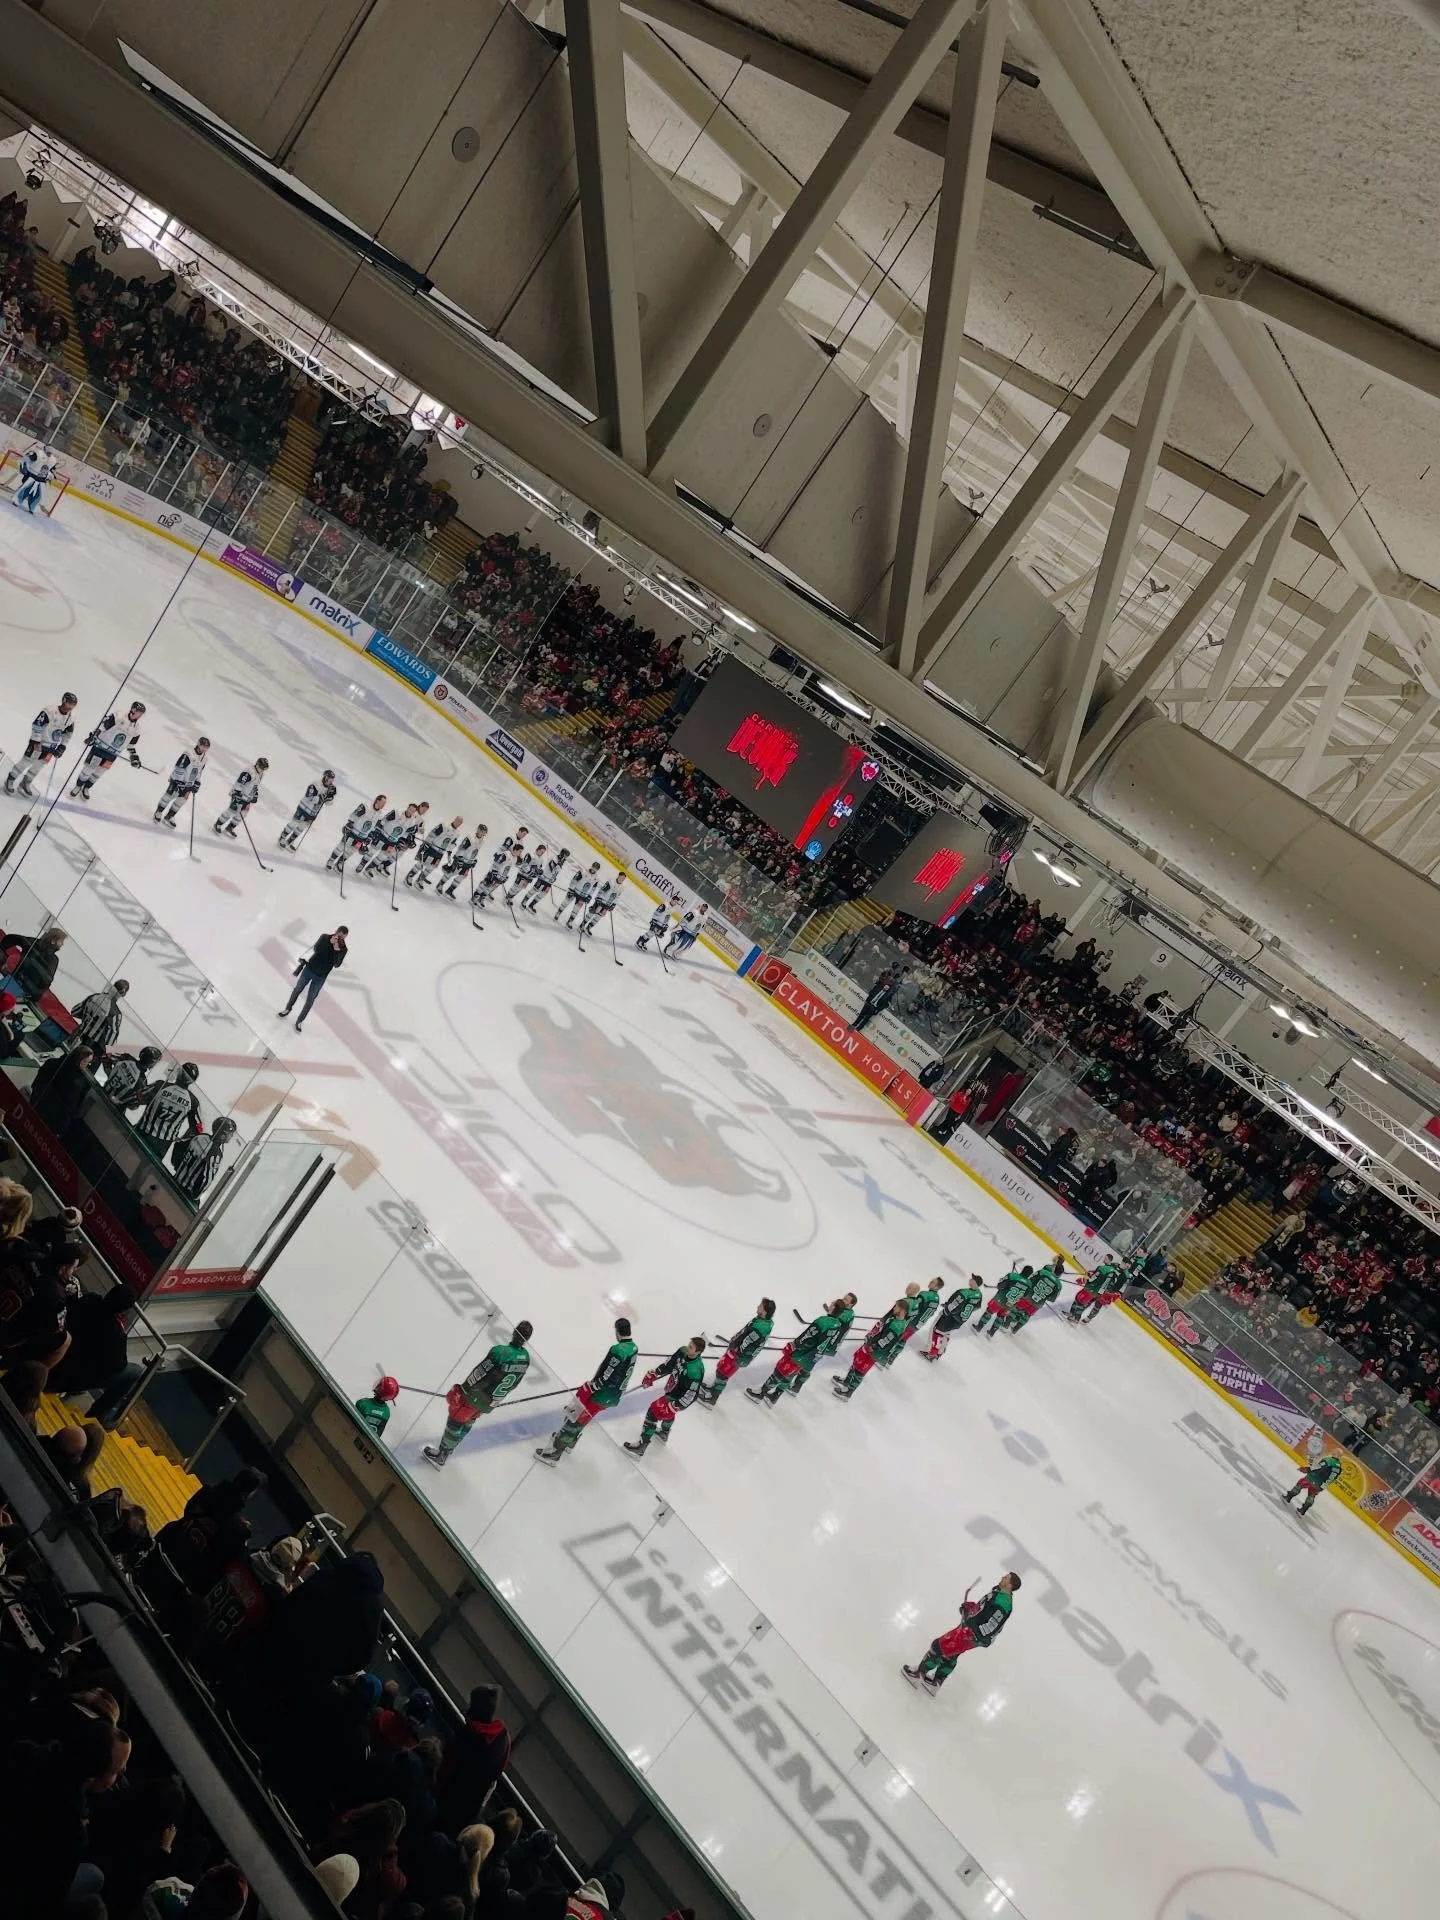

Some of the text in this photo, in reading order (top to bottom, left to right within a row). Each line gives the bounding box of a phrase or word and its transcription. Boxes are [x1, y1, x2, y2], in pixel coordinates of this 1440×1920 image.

[309, 597, 360, 637] matrix
[377, 636, 433, 680] EDWARDS
[543, 785, 578, 817] FURNISHINGS
[555, 784, 575, 801] FLOOR
[1156, 953, 1167, 963] 9
[778, 981, 859, 1054] CLAYTON
[862, 1055, 912, 1100] HOTELS
[658, 1005, 926, 1225] matrix
[1000, 1171, 1034, 1203] BIJOU
[1068, 1230, 1104, 1263] BIJOU
[181, 1275, 225, 1284] DRAGON
[492, 1373, 518, 1397] 2
[1210, 1372, 1256, 1395] PURPLE
[1085, 1501, 1289, 1702] Howells
[648, 1548, 774, 1691] CARDIFF
[963, 1515, 1303, 1858] matrix
